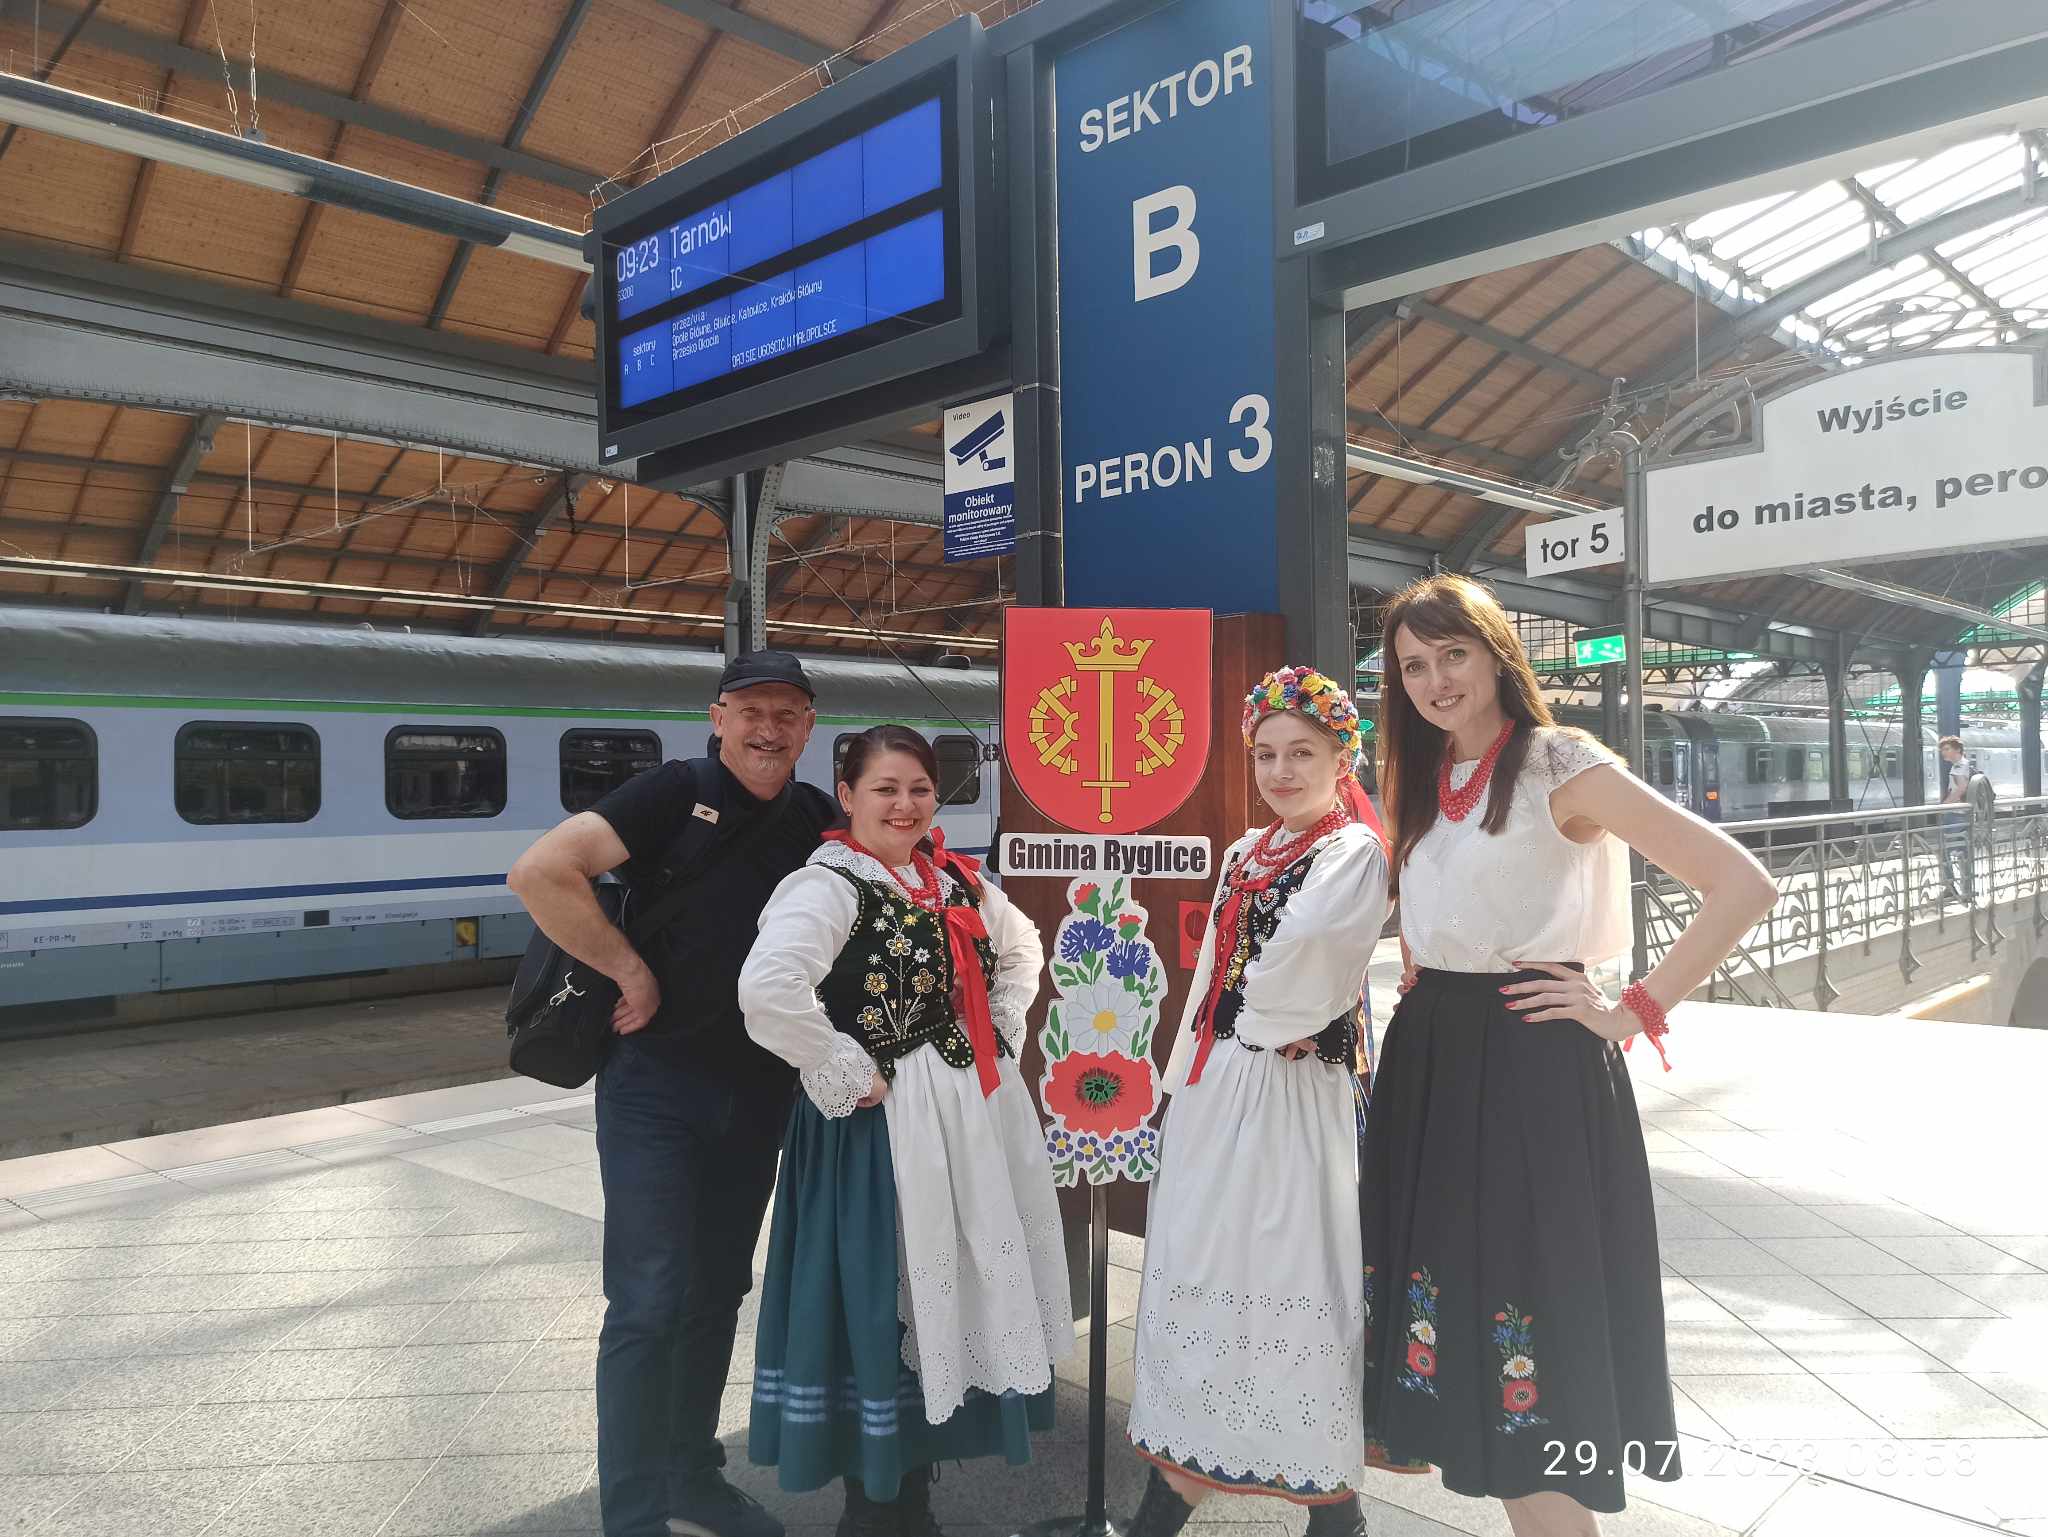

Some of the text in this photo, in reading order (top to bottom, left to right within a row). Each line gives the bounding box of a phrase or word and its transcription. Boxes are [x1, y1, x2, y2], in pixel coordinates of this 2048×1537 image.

[1080, 44, 1254, 153] SEKTOR
[617, 210, 732, 282] 09:23 Tarnów
[1133, 185, 1200, 303] B
[670, 266, 682, 291] IC
[738, 302, 769, 321] Katowice,
[770, 288, 796, 308] Kraków
[633, 340, 656, 357] sektory
[952, 412, 971, 422] Video
[1816, 388, 1968, 434] Wyjście
[1076, 393, 1273, 503] PERON 3
[948, 503, 1013, 523] monitorowany
[964, 492, 995, 508] Obiekt
[1692, 505, 1740, 534] do
[1754, 482, 1917, 526] miasta,
[1540, 522, 1610, 563] tor 5
[1008, 836, 1207, 878] Gmina Ryglice
